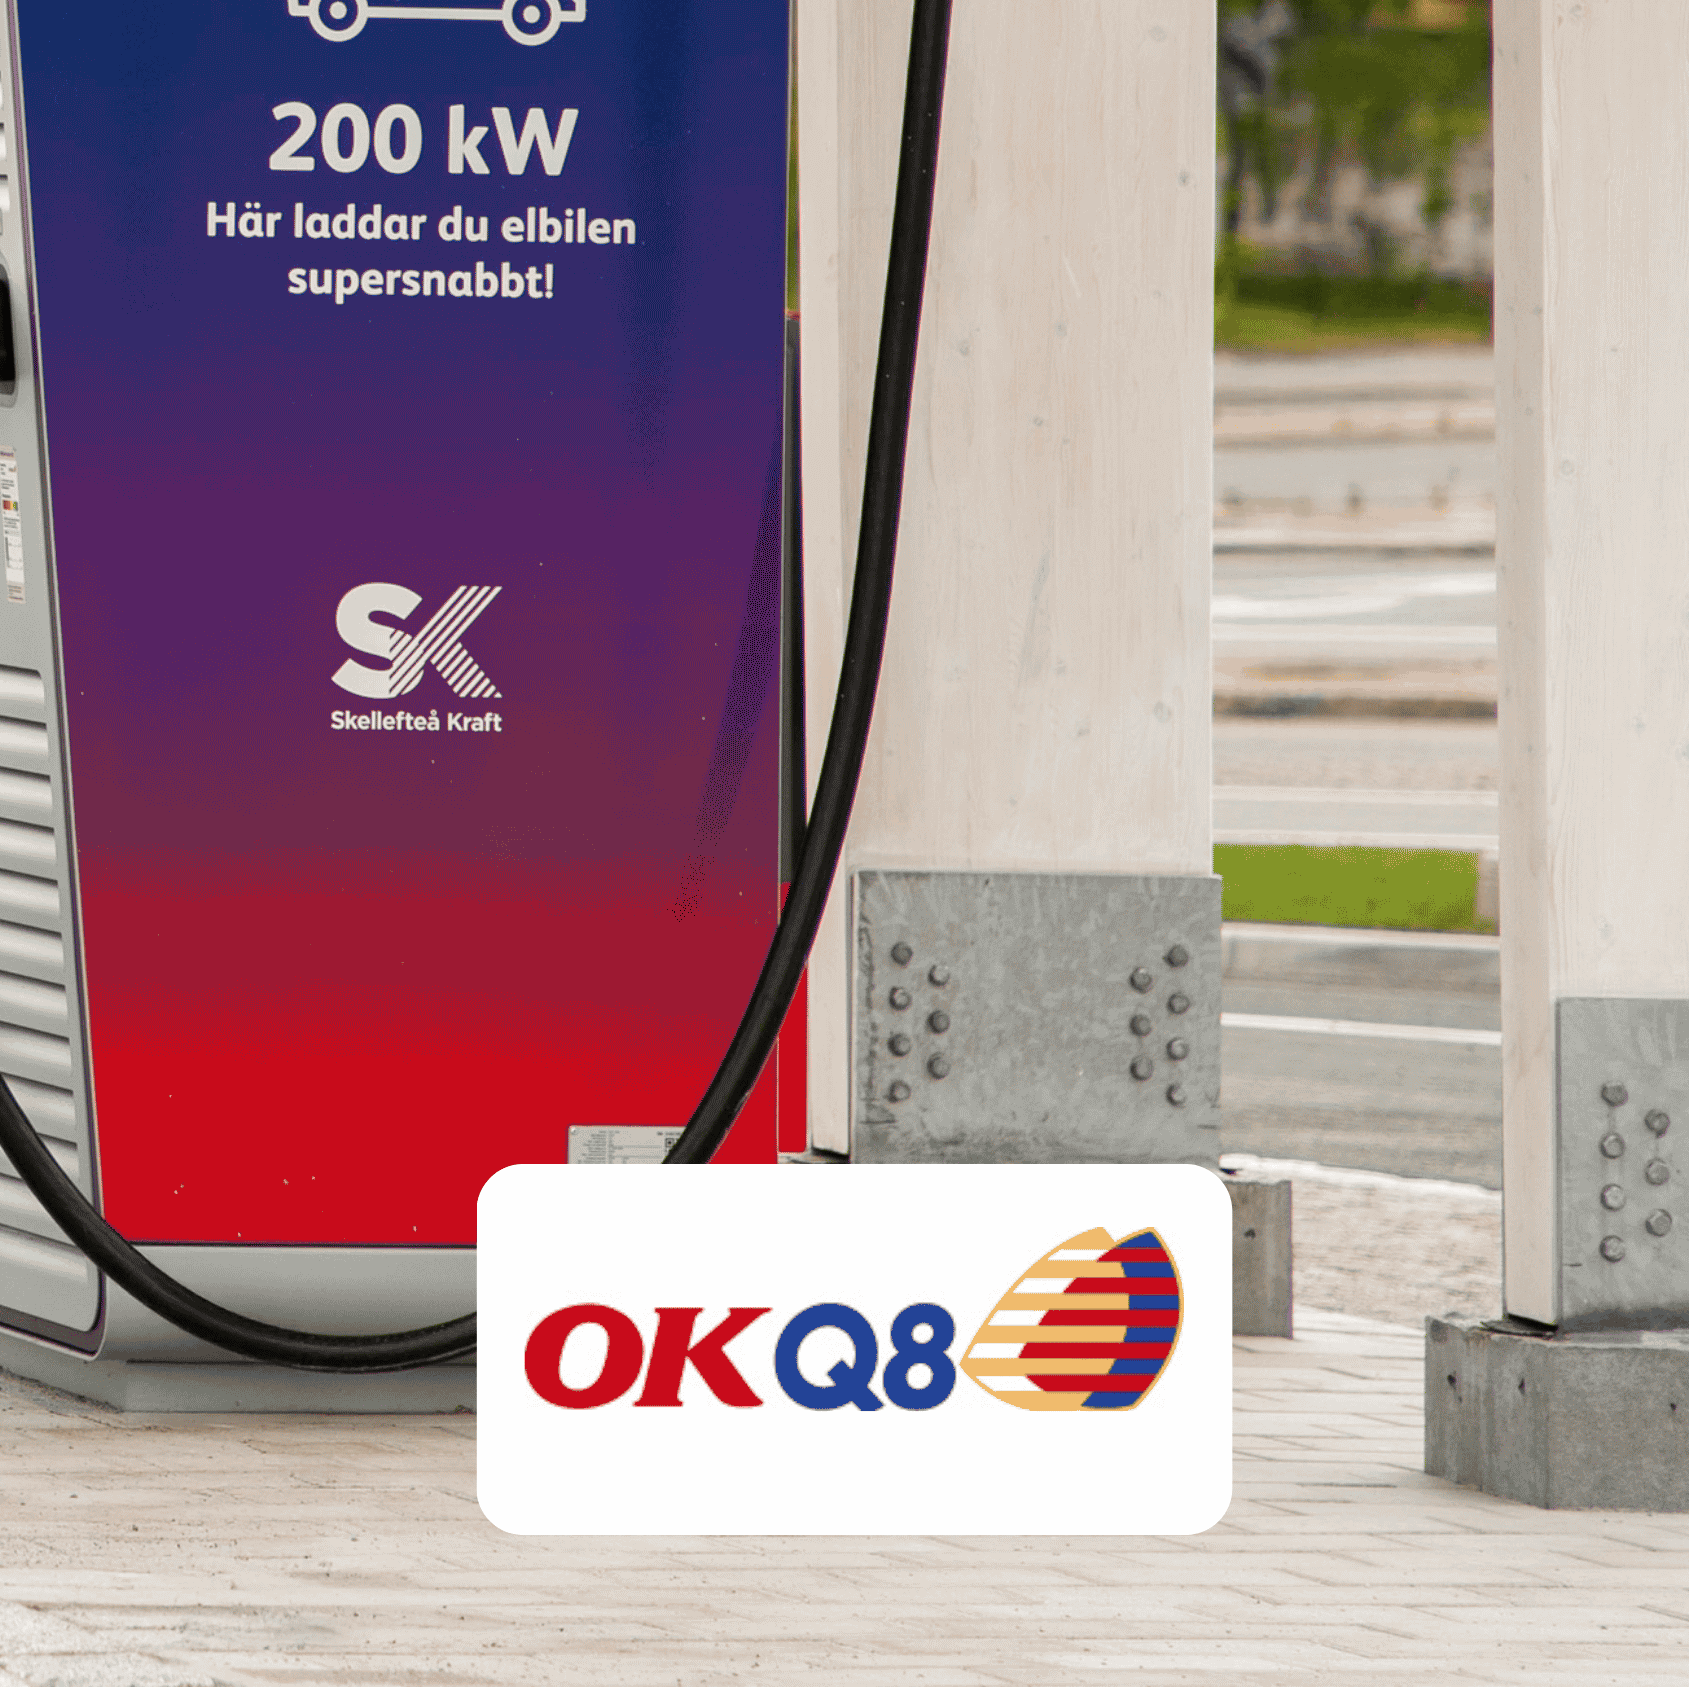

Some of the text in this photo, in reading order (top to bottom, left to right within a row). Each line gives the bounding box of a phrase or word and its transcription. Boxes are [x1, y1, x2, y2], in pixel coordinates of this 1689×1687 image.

[268, 100, 579, 176] 200 kW
[207, 200, 636, 245] Här laddar du elbilen
[288, 261, 554, 305] supersnabbt!
[331, 708, 503, 733] Skellefteå Kraft
